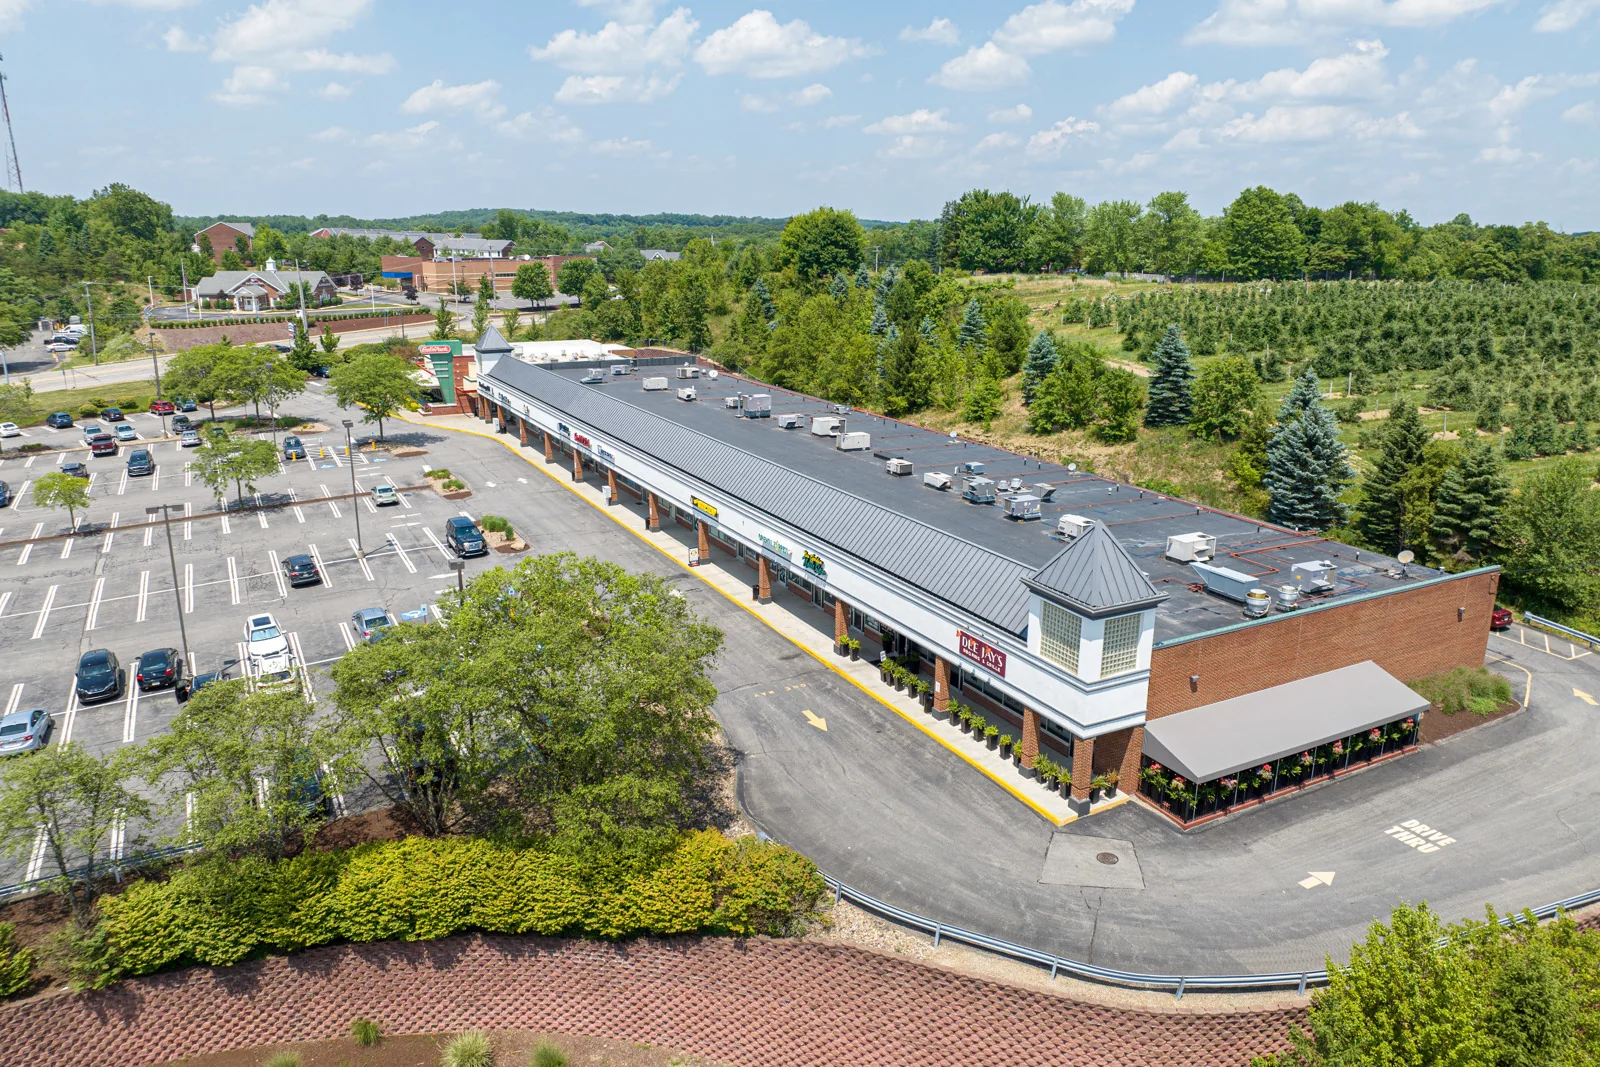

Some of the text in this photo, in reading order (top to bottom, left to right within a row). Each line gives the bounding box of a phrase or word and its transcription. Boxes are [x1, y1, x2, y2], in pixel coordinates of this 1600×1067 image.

[753, 683, 807, 698] ONE WAY
[1384, 825, 1441, 853] THRU
[1400, 819, 1457, 847] DRIVE
